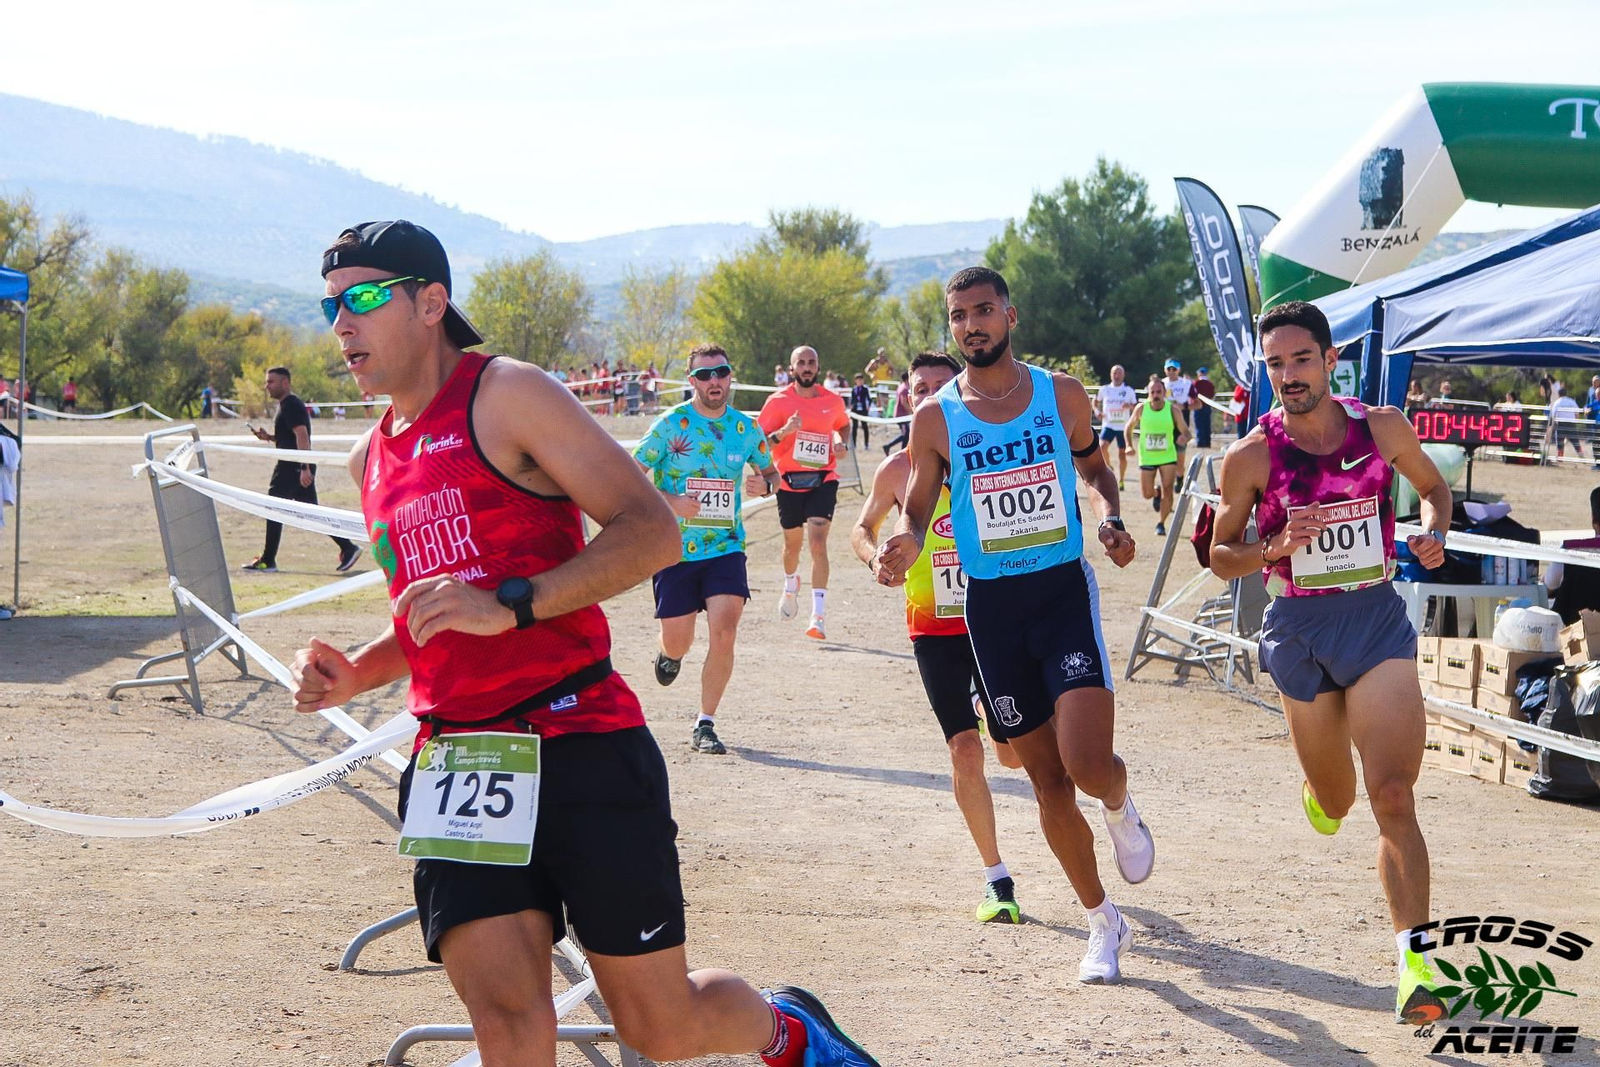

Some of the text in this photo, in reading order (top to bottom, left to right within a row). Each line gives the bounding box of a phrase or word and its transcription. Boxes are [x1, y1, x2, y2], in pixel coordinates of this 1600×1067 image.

[1549, 98, 1600, 140] T
[798, 441, 826, 455] 1446
[962, 430, 1055, 472] nerja
[993, 470, 1031, 490] INTERNACIONAL
[1029, 467, 1040, 482] DEL
[694, 491, 730, 508] 419
[981, 484, 1055, 520] 1002
[395, 483, 465, 534] FUNDACIÓN
[1350, 504, 1361, 518] DEL
[1017, 517, 1027, 525] Es
[1009, 525, 1039, 537] Zakaria
[399, 514, 480, 580] ALBOR
[939, 553, 953, 565] CROSS
[1325, 552, 1350, 562] Fontes
[1326, 562, 1356, 573] Ignacio
[435, 772, 515, 819] 125
[445, 830, 466, 838] Castro
